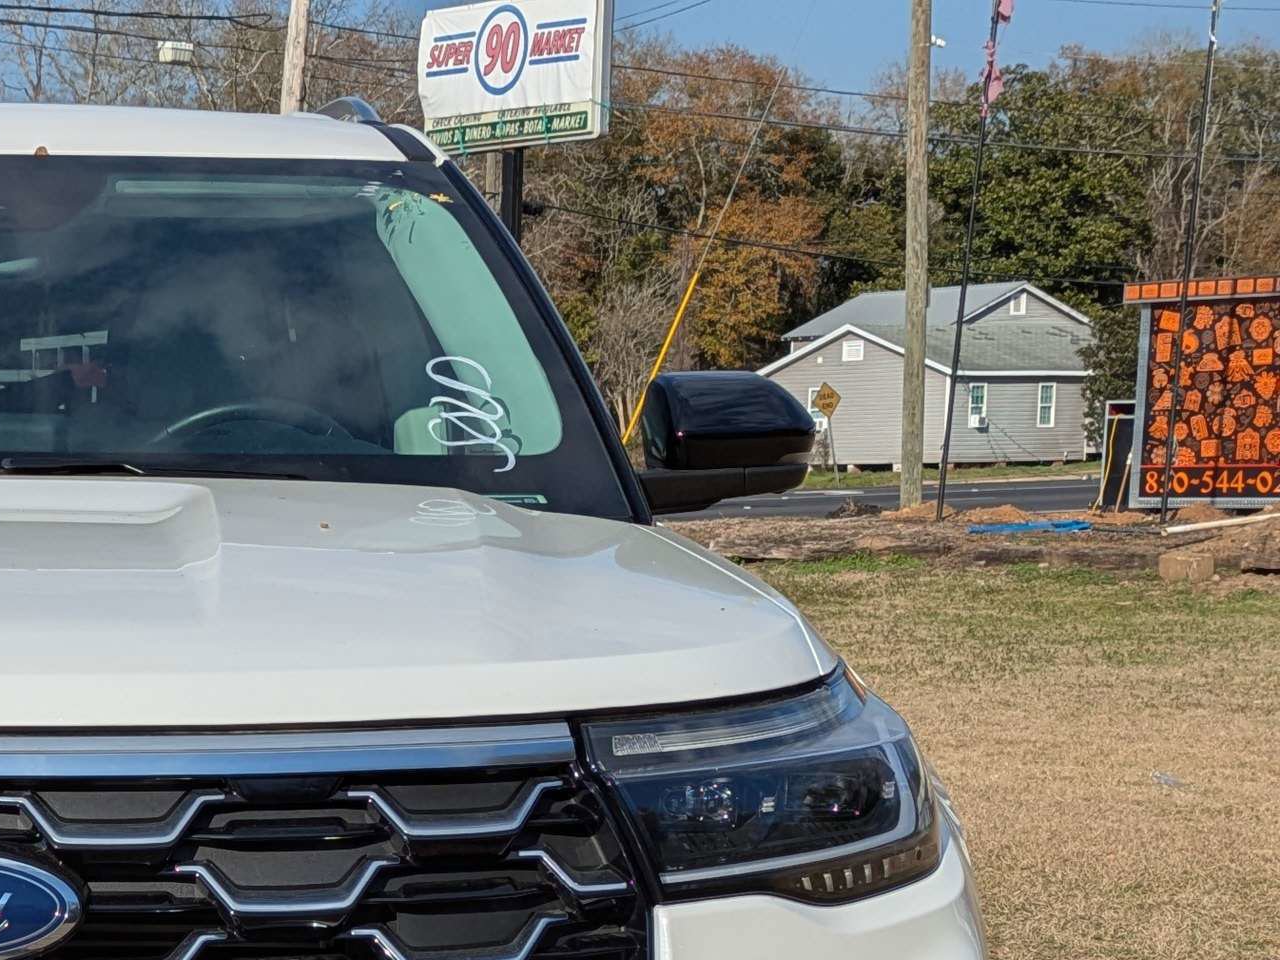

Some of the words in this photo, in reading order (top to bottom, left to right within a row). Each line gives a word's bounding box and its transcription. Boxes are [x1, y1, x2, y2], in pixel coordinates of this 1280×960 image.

[426, 40, 474, 70] SUPER
[483, 21, 521, 77] 90
[529, 26, 586, 58] MARKET
[550, 113, 587, 131] MARKET
